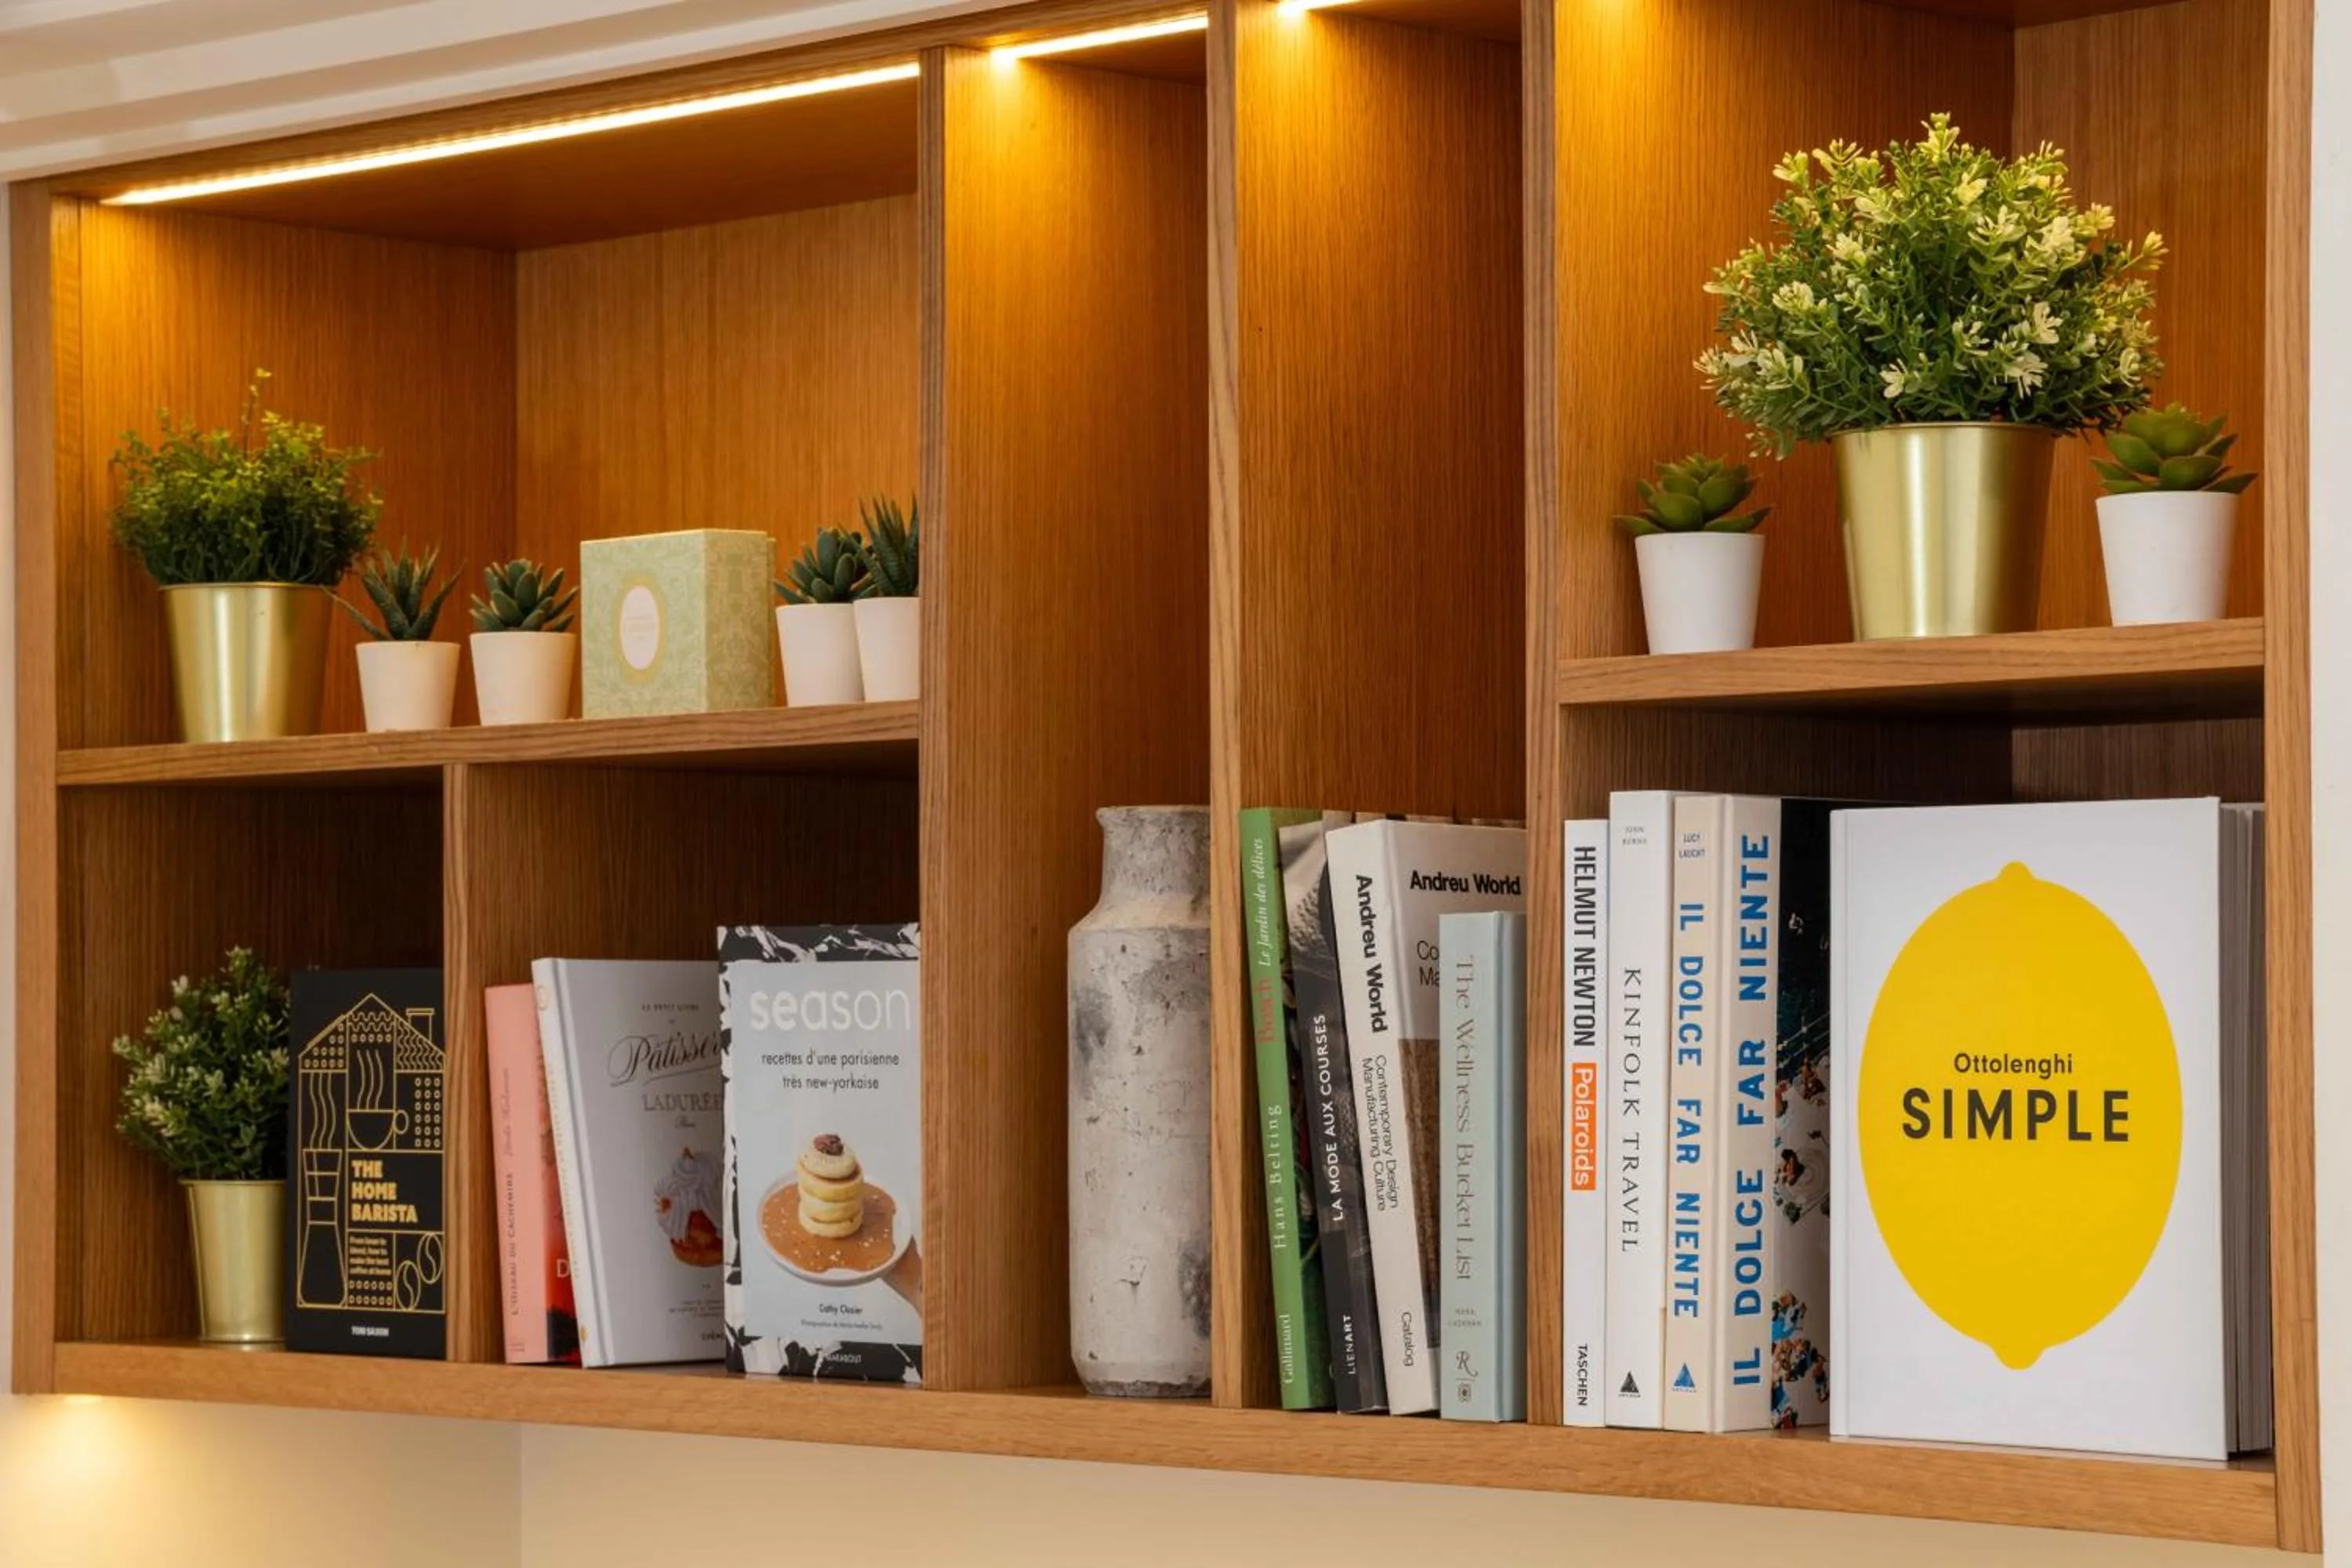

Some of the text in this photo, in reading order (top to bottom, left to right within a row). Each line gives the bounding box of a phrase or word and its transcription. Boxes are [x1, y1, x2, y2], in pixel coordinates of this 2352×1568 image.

[1251, 837, 1271, 967] Le Jardin des délices
[1410, 869, 1522, 895] Andreu World
[1356, 874, 1388, 1033] Andreu World
[1573, 847, 1596, 1047] HELMUT NEWTON
[750, 989, 911, 1032] season
[1456, 954, 1475, 1010] The
[608, 1032, 721, 1087] Pâtisser
[760, 1047, 900, 1070] recettes d'une parisienne
[782, 1072, 880, 1093] très new-yorkaise
[1456, 1018, 1475, 1133] Wellness
[1954, 1052, 2073, 1080] Ottolenghi
[1313, 1014, 1343, 1221] LA MODE AUX COURSES
[1363, 1058, 1386, 1211] Manufacturing Culture
[1375, 1054, 1399, 1208] Contemporary Design
[1574, 1068, 1594, 1185] Polaroids
[1622, 967, 1641, 1253] KINFOLK TRAVEL
[1674, 904, 1704, 1318] IL DOLCE FAR NIENTE
[1732, 834, 1769, 1386] IL DOLCE FAR NIENTE
[1902, 1087, 2129, 1142] SIMPLE
[351, 1160, 383, 1178] THE
[351, 1182, 397, 1200] HOME
[1267, 1105, 1287, 1249] Hans Belting
[1456, 1144, 1475, 1228] Bucket
[351, 1203, 419, 1223] BARISTA
[1279, 1315, 1293, 1383] Gallimard
[1342, 1314, 1356, 1375] LIENART
[1401, 1312, 1415, 1367] Catalog
[1577, 1343, 1588, 1406] TASCHEN
